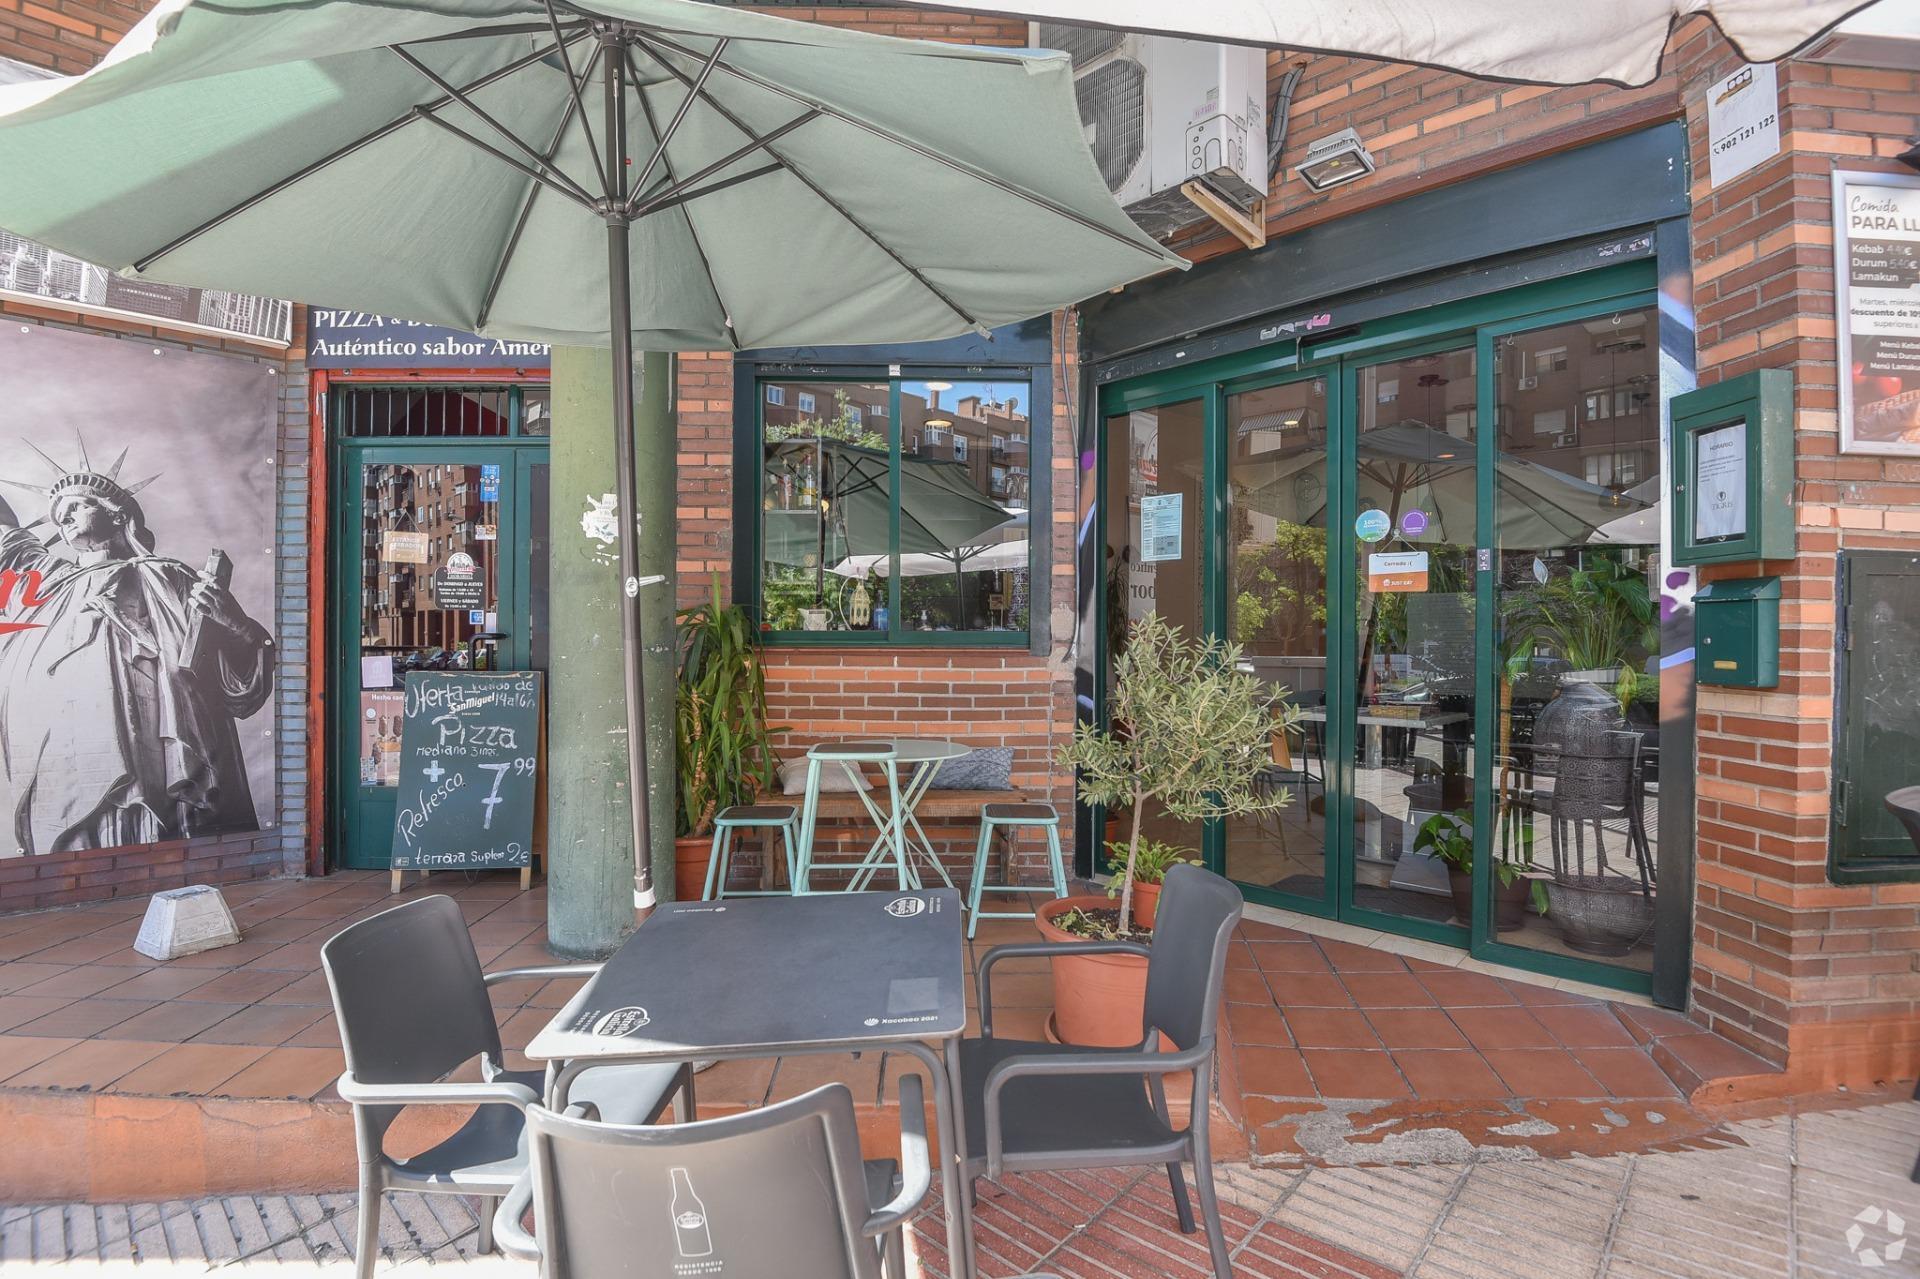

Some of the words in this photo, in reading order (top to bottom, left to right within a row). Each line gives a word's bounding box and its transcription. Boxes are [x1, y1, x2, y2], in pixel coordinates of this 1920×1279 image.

[1720, 138, 1737, 152] 902
[1739, 127, 1755, 141] 121
[1758, 114, 1776, 130] 122
[1851, 195, 1899, 213] Comida
[1852, 216, 1899, 230] PARA
[1852, 244, 1885, 254] Kebab
[1852, 258, 1888, 268] Durum
[314, 310, 384, 328] PIZZA
[1850, 308, 1895, 317] descuento
[1897, 309, 1908, 317] de
[312, 338, 417, 356] Auténtico
[422, 336, 486, 356] sabor
